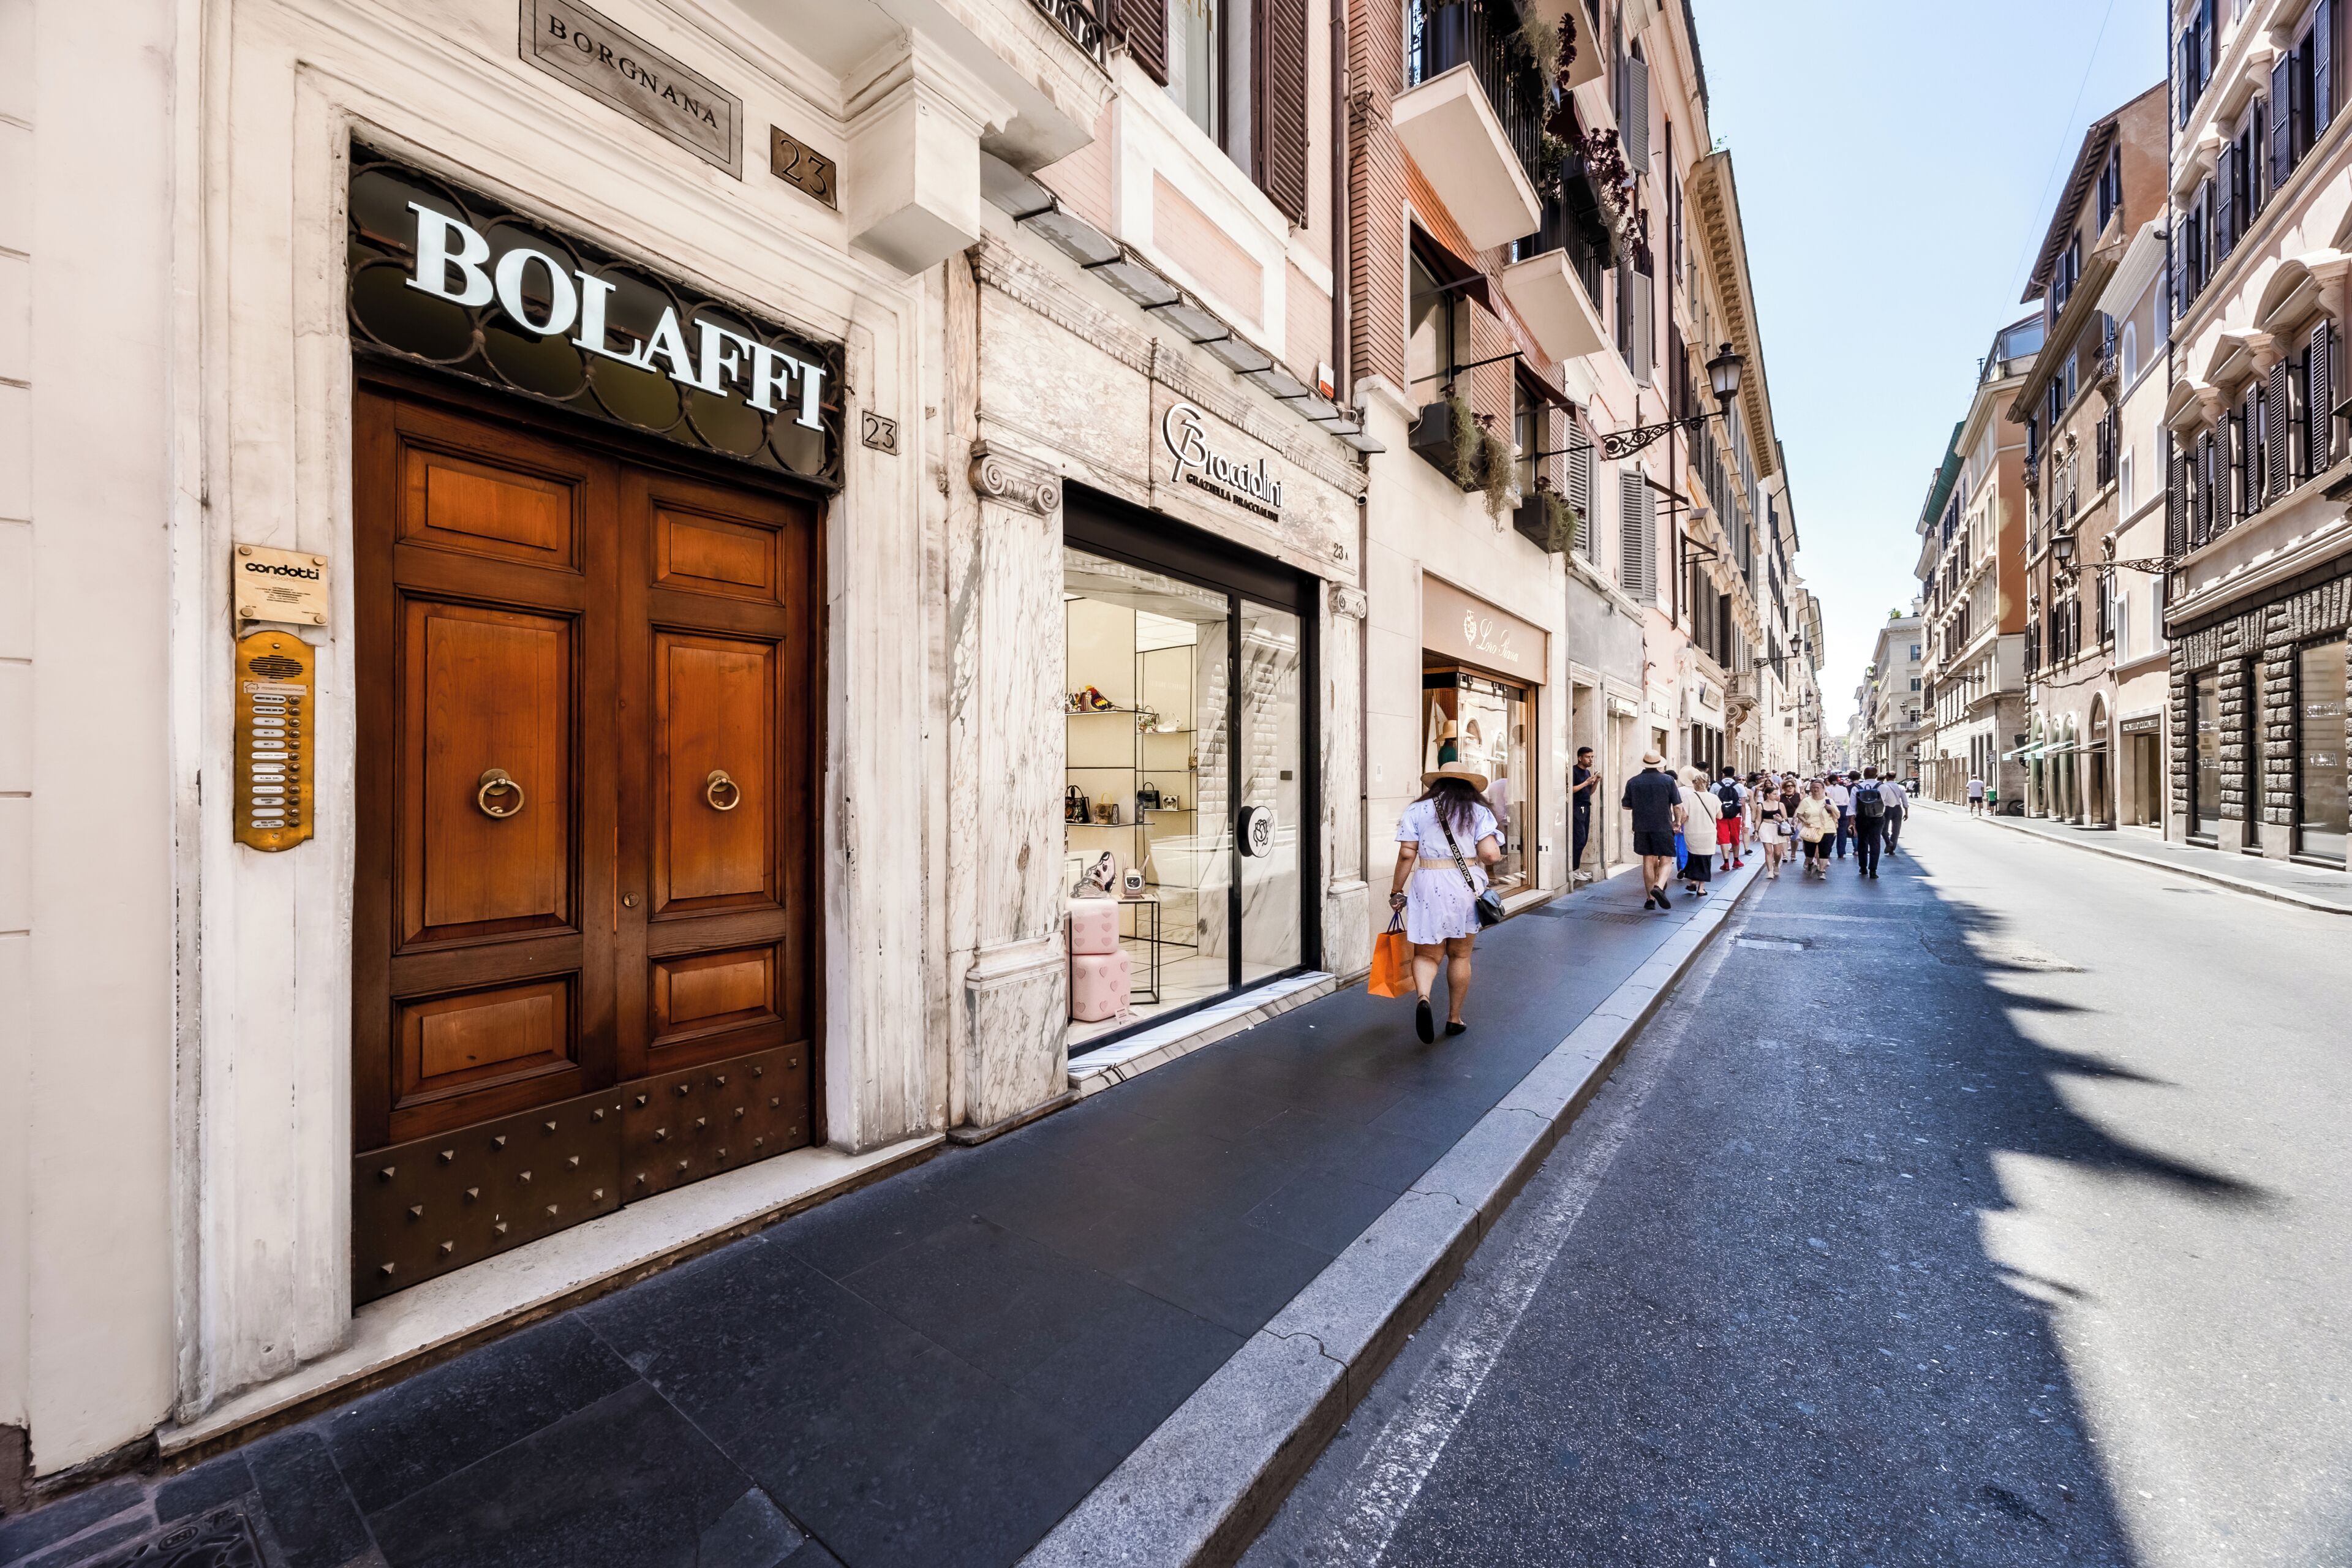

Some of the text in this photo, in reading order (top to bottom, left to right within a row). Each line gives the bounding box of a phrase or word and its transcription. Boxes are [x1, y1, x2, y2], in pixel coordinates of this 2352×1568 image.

[548, 13, 719, 130] BORGNANA
[780, 138, 827, 195] 23
[404, 201, 826, 432] BOLAFFI
[865, 418, 894, 448] 23
[1186, 473, 1279, 522] GRAZIELLA BRACCIALINI
[245, 562, 319, 580] condotti
[1333, 543, 1343, 560] 23
[1476, 618, 1497, 654] Loro
[1450, 843, 1472, 882] LOUIS VUITTON
